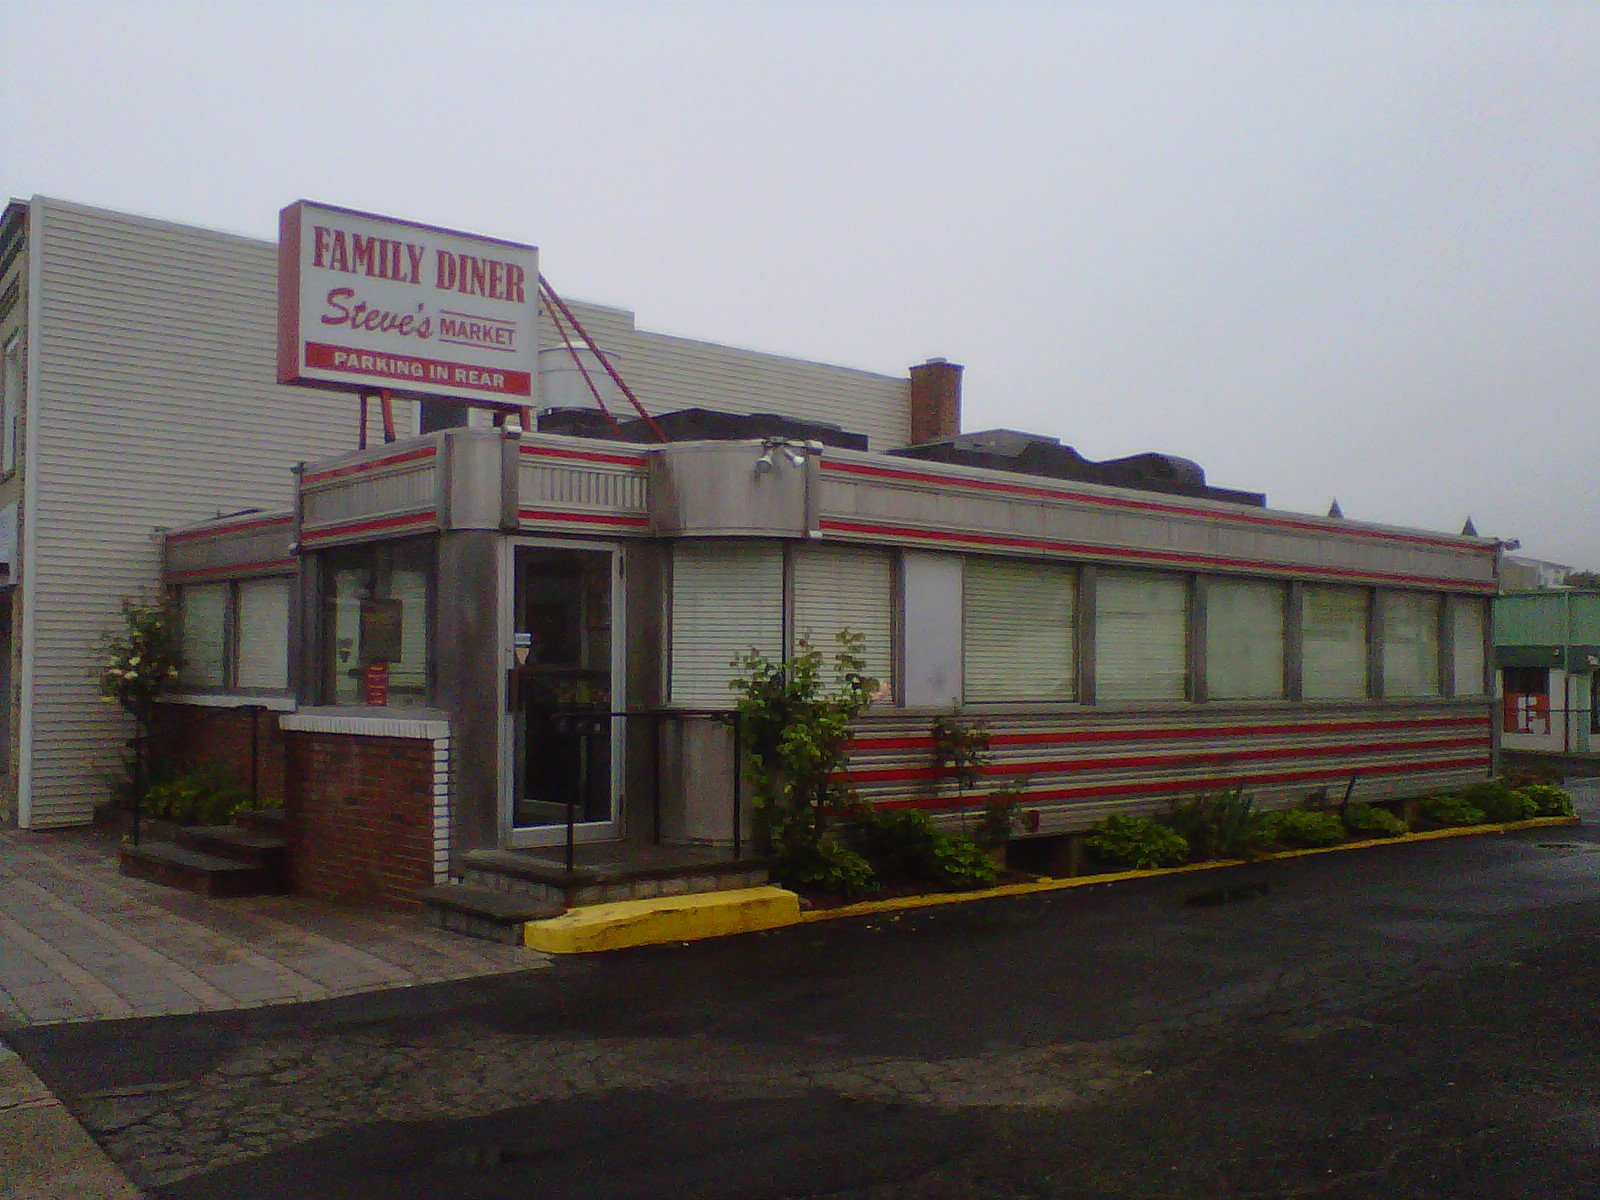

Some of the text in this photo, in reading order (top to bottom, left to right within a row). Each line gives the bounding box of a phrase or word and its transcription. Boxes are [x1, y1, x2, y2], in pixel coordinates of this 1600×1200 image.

[313, 226, 525, 304] FAMILY DINER
[321, 287, 517, 345] Steve's MARKET
[333, 351, 505, 388] PARKING IN REAR
